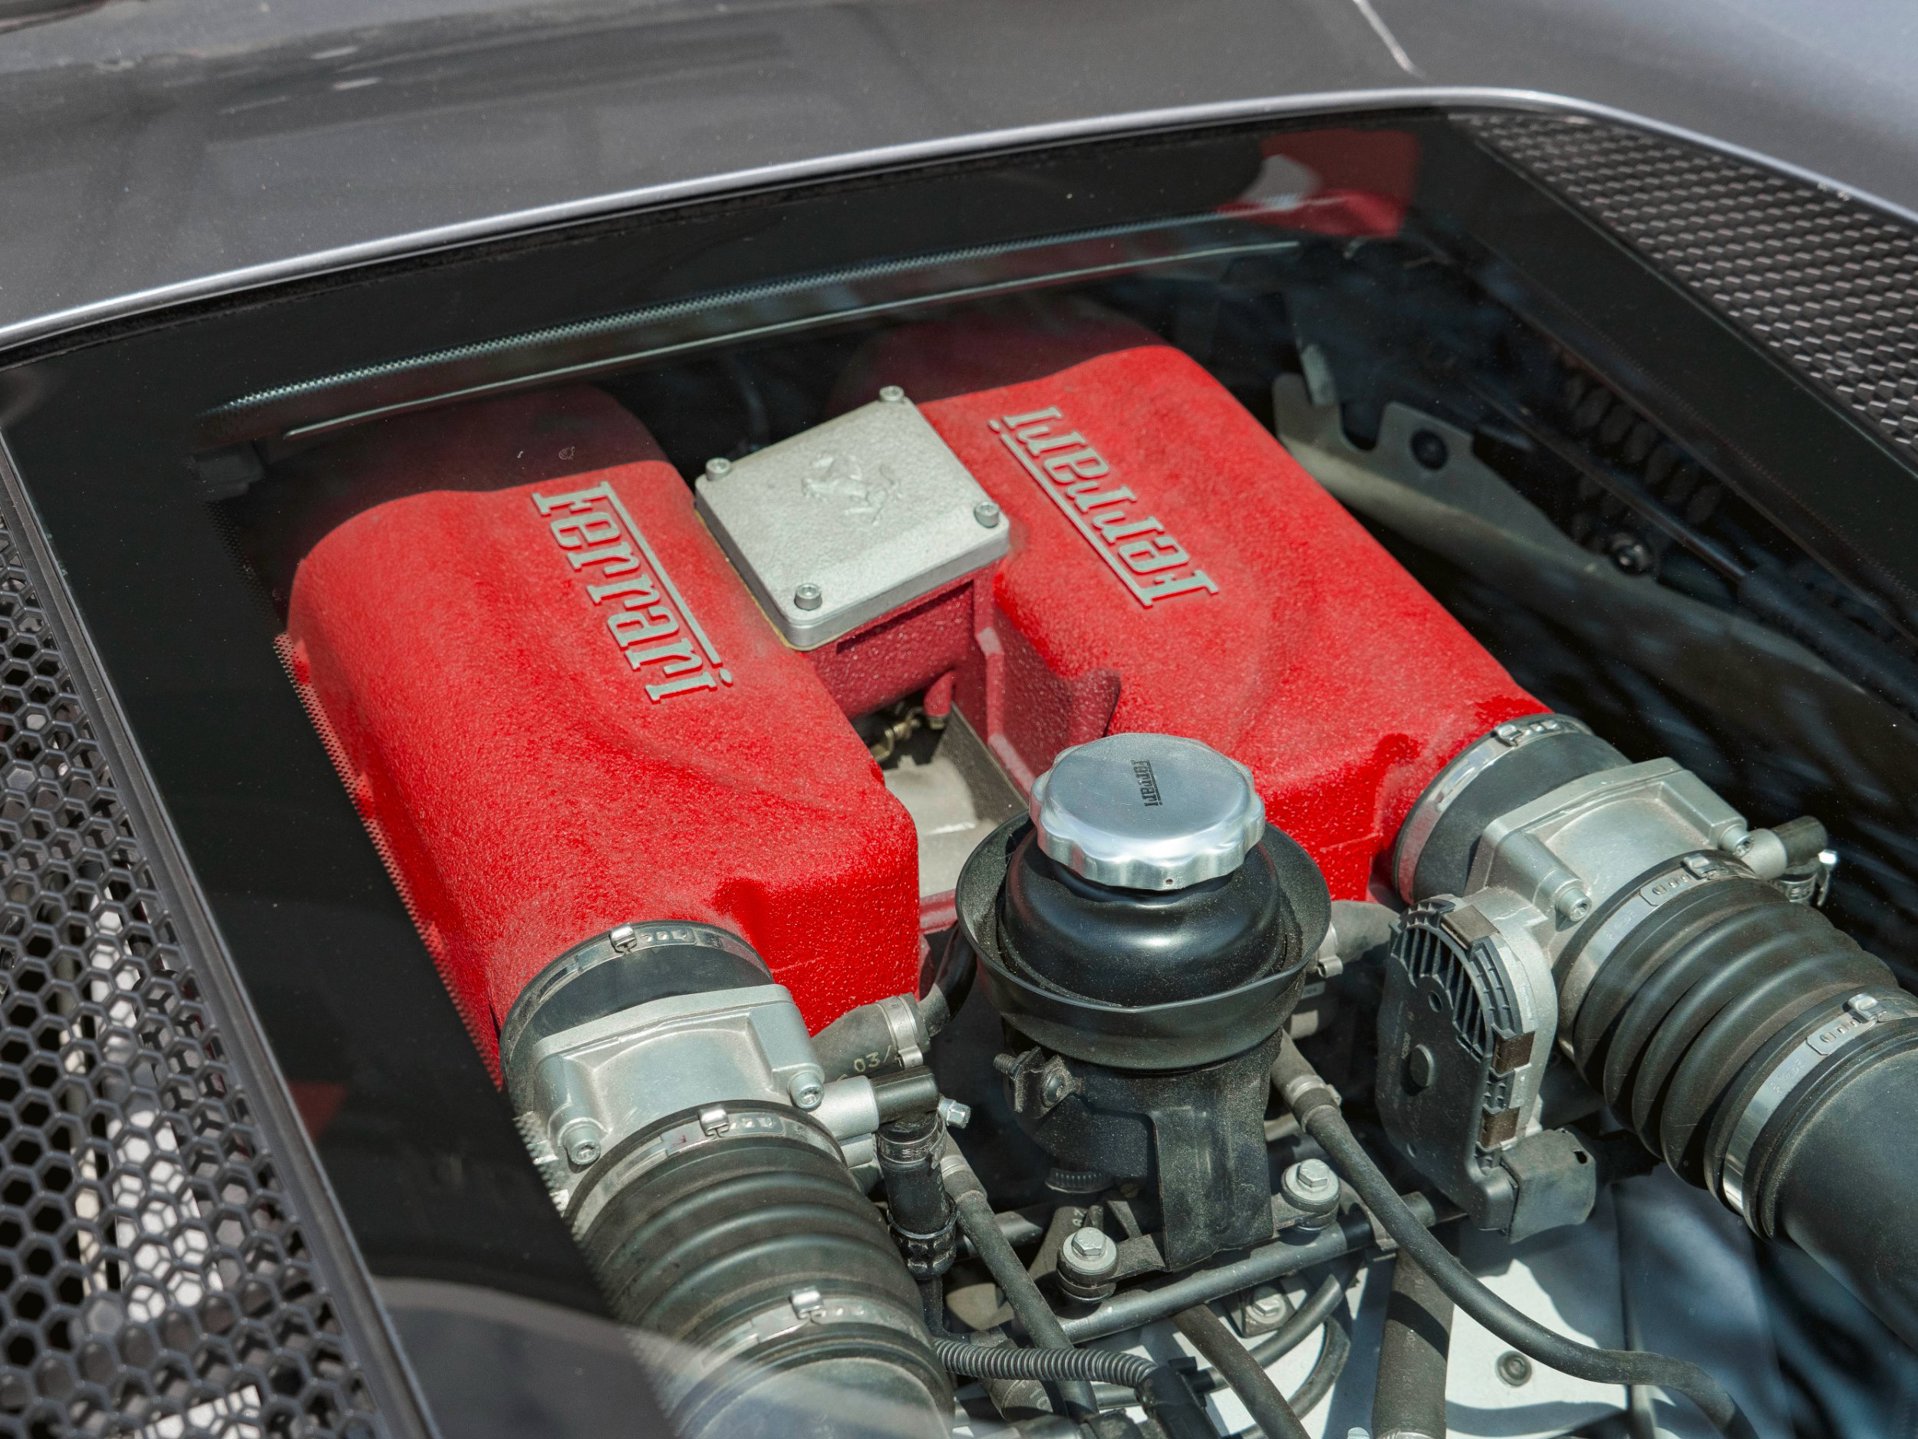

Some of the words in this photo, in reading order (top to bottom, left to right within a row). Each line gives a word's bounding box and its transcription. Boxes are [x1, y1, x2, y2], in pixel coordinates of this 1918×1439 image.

[531, 481, 733, 703] Ferrari
[988, 406, 1219, 608] Ferrari
[1131, 760, 1163, 807] Ferrari
